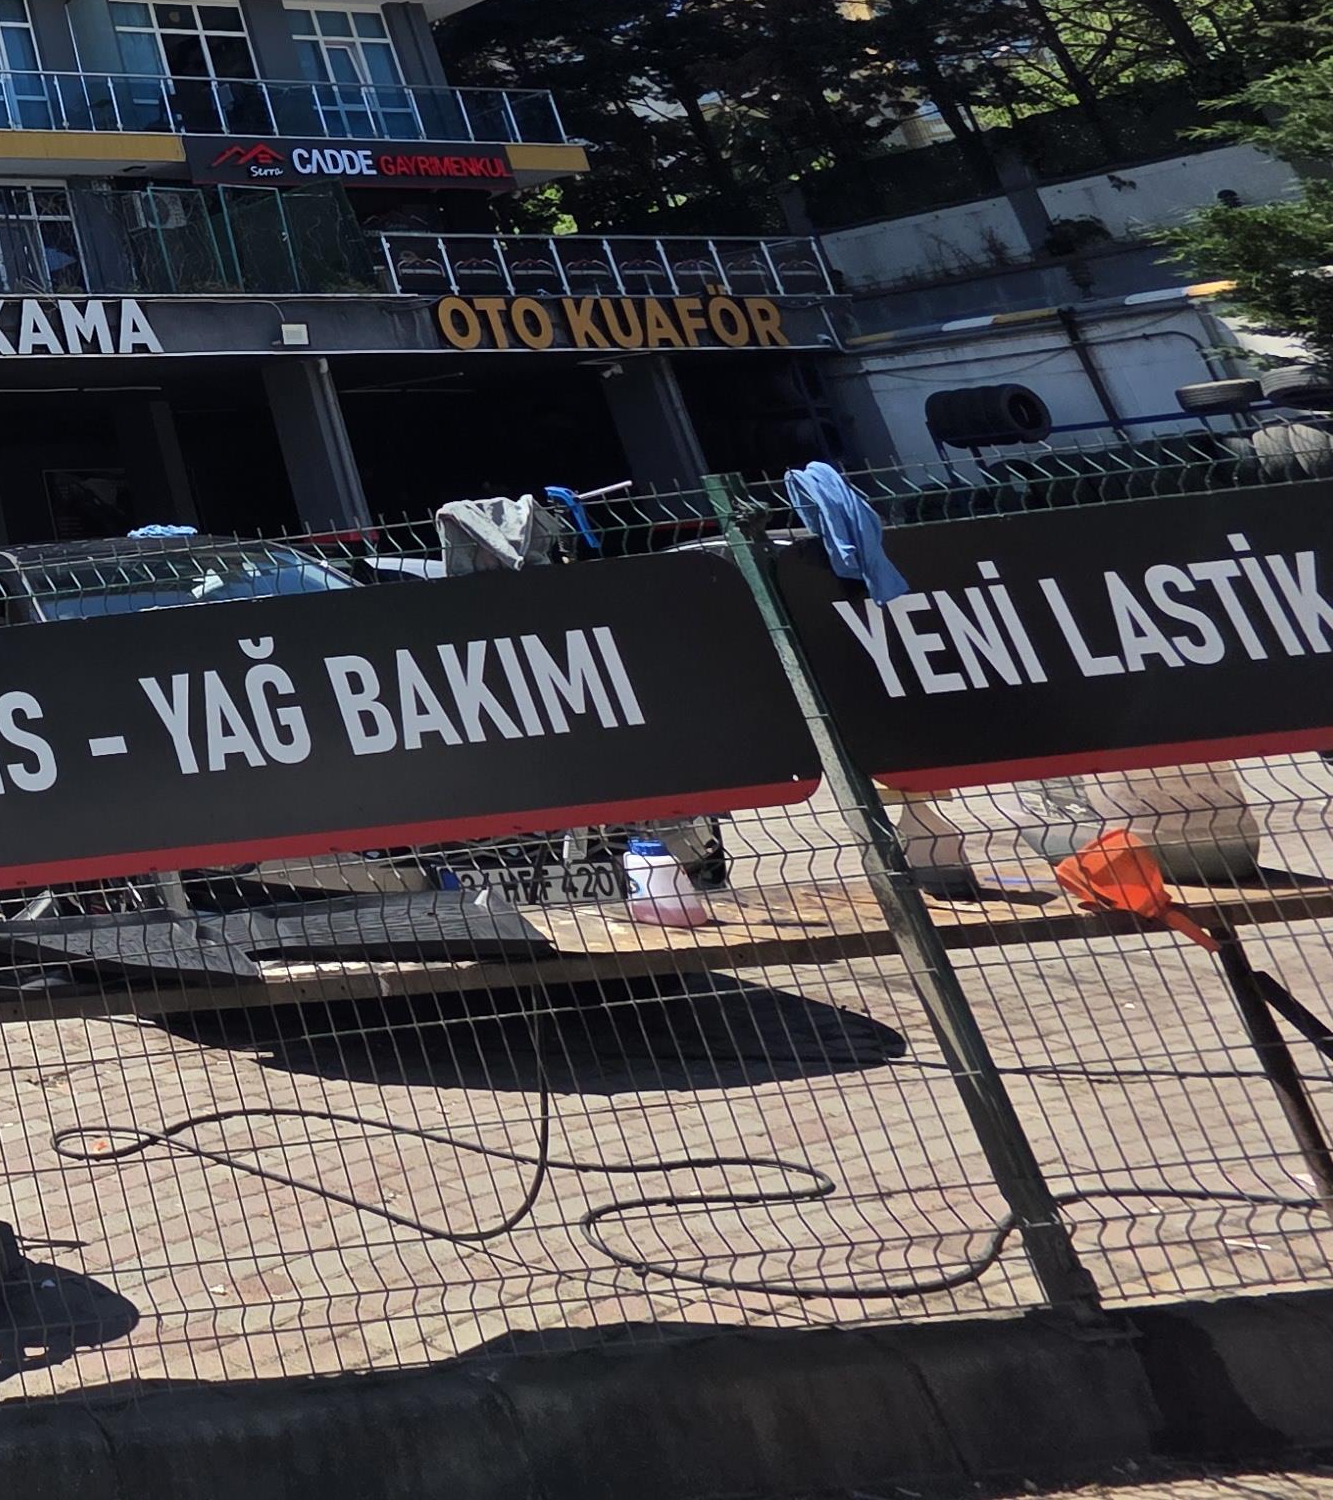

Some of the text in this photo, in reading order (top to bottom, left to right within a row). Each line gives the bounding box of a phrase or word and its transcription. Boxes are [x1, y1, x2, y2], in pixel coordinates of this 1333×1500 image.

[250, 164, 284, 178] Serra
[292, 148, 378, 176] CADDE
[438, 284, 790, 350] OTO KUAFÖR
[831, 532, 1333, 698] YENİ LASTİK
[137, 636, 313, 775] YAĞ
[323, 626, 646, 757] BAKIMI
[561, 864, 614, 900] 420
